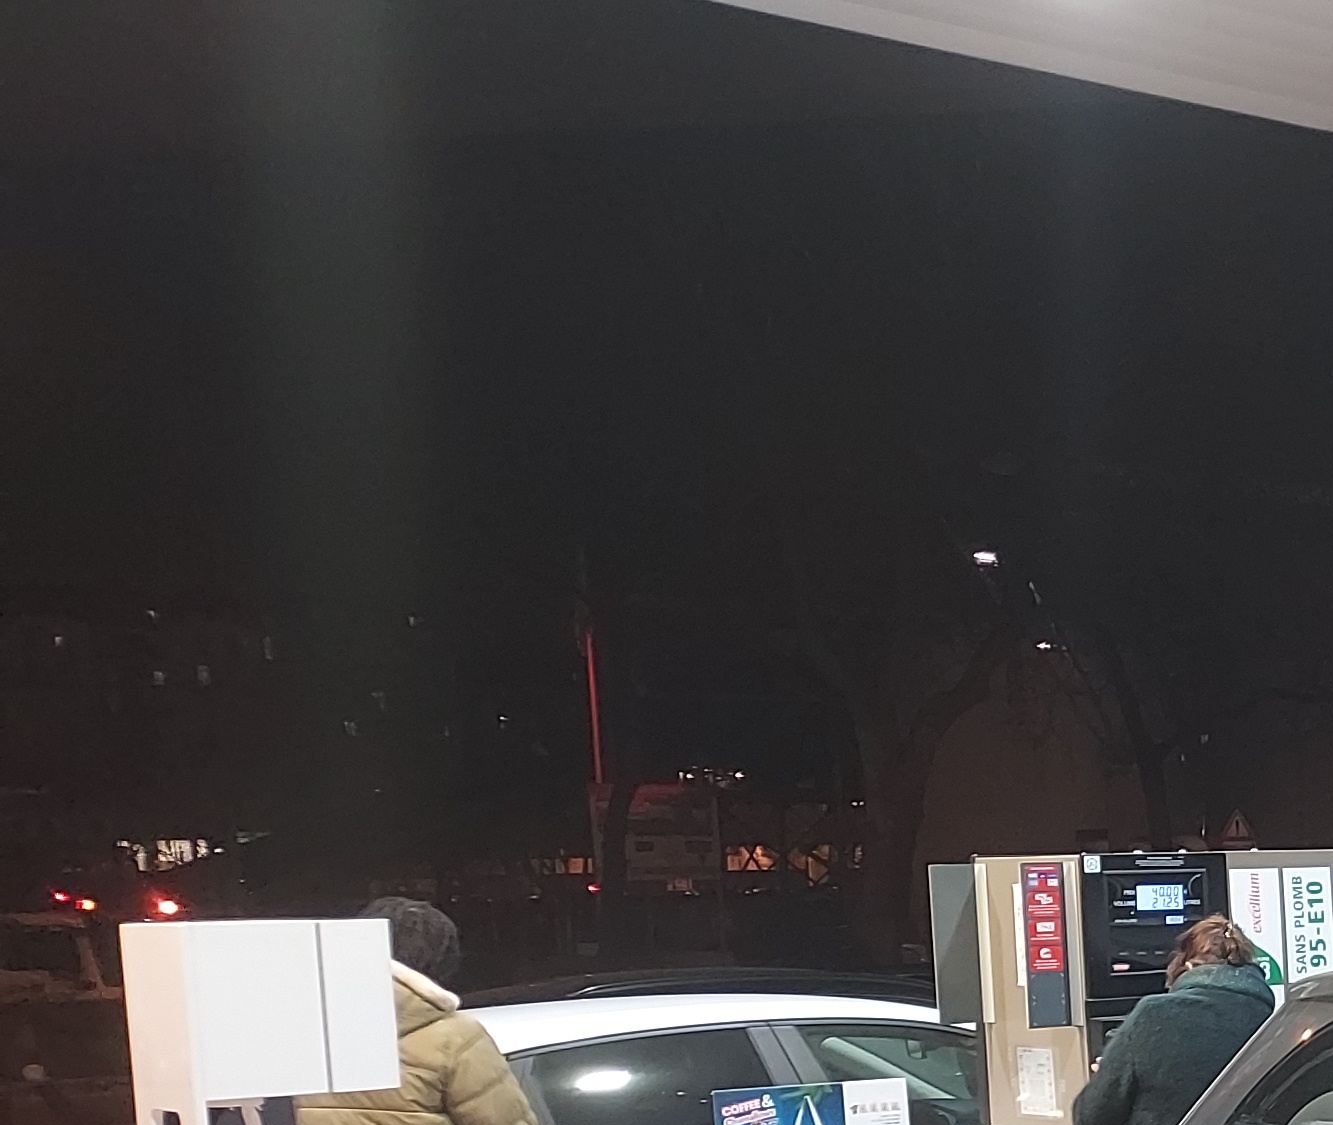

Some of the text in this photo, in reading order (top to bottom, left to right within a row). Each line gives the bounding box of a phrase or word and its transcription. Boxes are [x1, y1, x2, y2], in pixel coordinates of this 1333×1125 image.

[1291, 876, 1308, 975] SANS PLOMB
[1306, 881, 1328, 968] 95-E10
